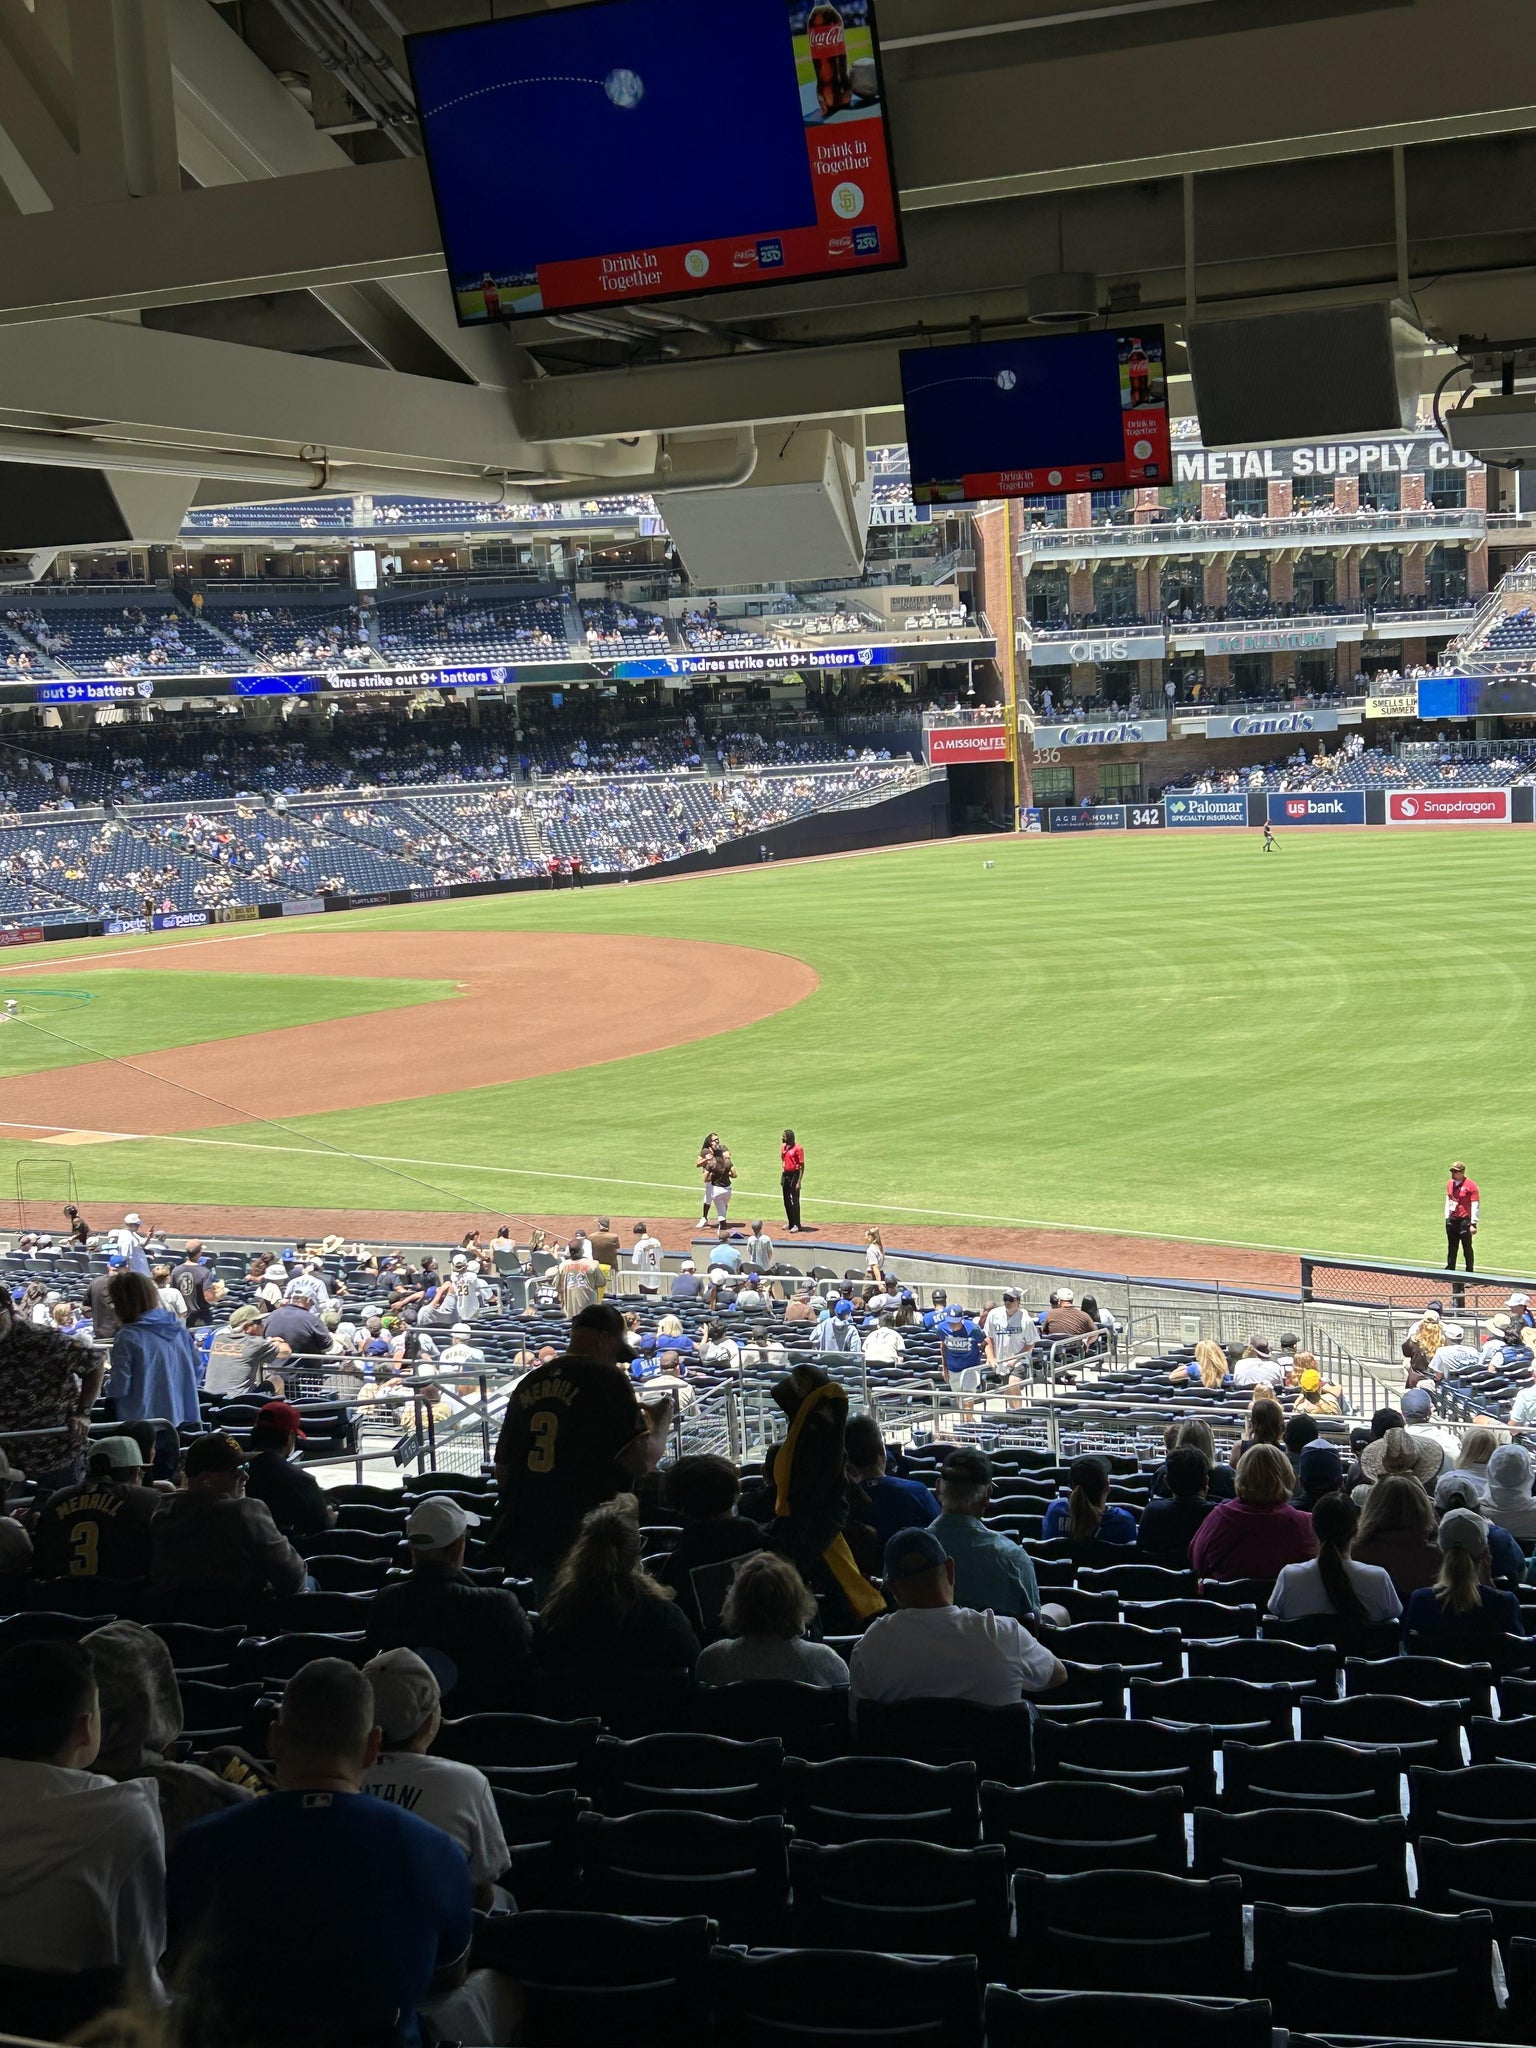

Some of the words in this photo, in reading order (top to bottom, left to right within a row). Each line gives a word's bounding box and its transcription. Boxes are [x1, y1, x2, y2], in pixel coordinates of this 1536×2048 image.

[817, 142, 853, 160] Drink
[854, 140, 867, 155] in
[814, 155, 872, 175] Together
[602, 256, 642, 273] Drink
[643, 252, 657, 269] in
[599, 270, 663, 292] Together
[1126, 427, 1158, 436] Together
[1128, 420, 1149, 429] Drink
[1149, 419, 1157, 427] in
[1177, 449, 1284, 482] METAL
[1292, 442, 1415, 477] SUPPLY
[1001, 471, 1024, 482] Drink
[1024, 470, 1033, 480] in
[999, 480, 1035, 492] Together
[1287, 631, 1326, 648] TURF
[1069, 641, 1129, 663] ORIS
[682, 657, 726, 673] Padres
[727, 655, 764, 670] strike
[766, 655, 789, 668] out
[790, 653, 808, 667] 9+
[809, 651, 856, 666] batters
[359, 673, 393, 687] strike
[395, 673, 419, 686] out
[420, 671, 438, 685] 9+
[440, 669, 488, 684] batters
[67, 685, 85, 699] 9+
[87, 684, 136, 698] batters
[1372, 699, 1404, 708] SMELLS
[1381, 706, 1416, 715] SUMMER
[1231, 713, 1315, 736] Canel's
[1059, 722, 1143, 745] Canel's
[946, 738, 988, 749] MISSION
[1032, 747, 1061, 764] 336
[1188, 799, 1243, 814] Palomar
[1288, 803, 1305, 814] us
[1307, 799, 1345, 814] bank
[1423, 800, 1496, 814] Snapdragon
[1132, 808, 1160, 826] 342
[1171, 814, 1205, 822] SPECIALTY
[1206, 813, 1244, 821] INSURANCE
[176, 912, 207, 925] petco
[528, 1411, 559, 1473] 3
[55, 1492, 127, 1520] MERRILL
[68, 1520, 100, 1577] 3
